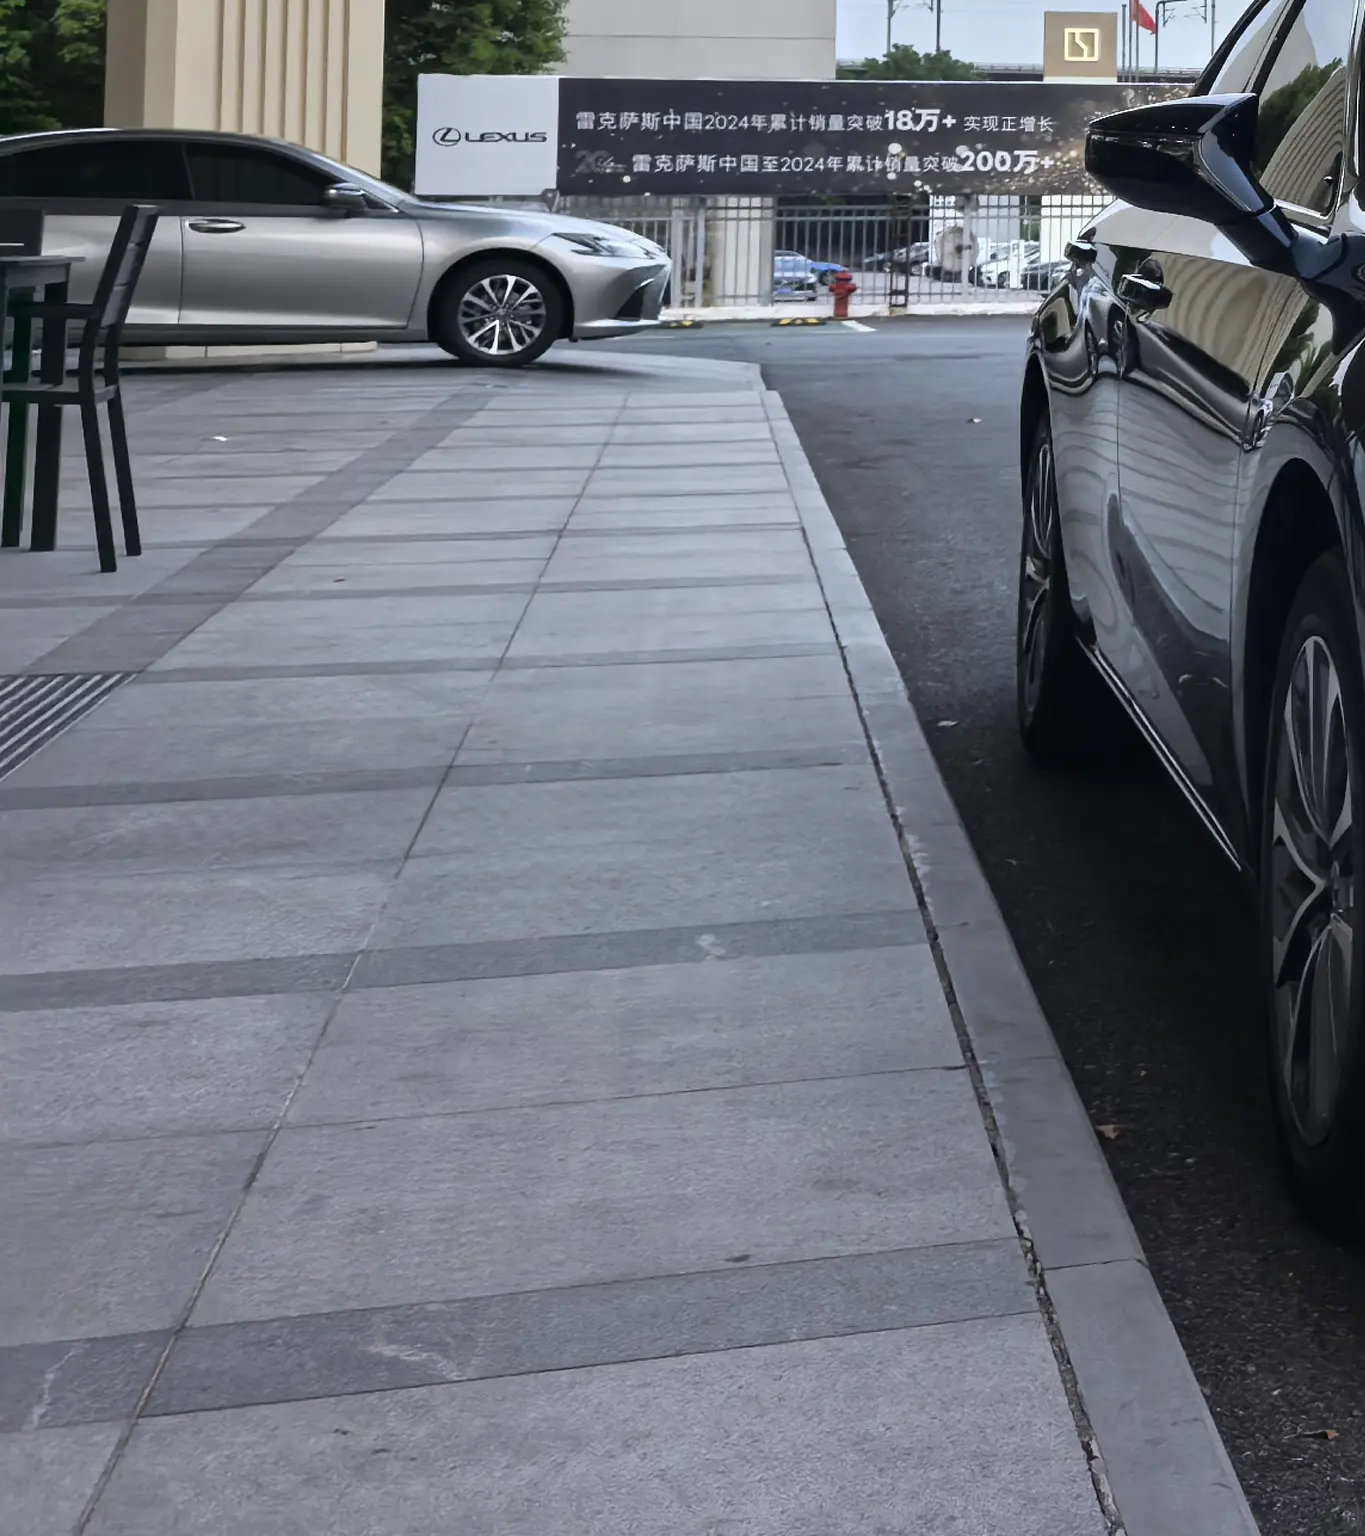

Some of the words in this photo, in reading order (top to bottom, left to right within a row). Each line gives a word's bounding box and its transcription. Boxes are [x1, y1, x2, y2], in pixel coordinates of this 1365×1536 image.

[963, 115, 1054, 133] 实现正增长
[464, 131, 548, 144] LEXUS
